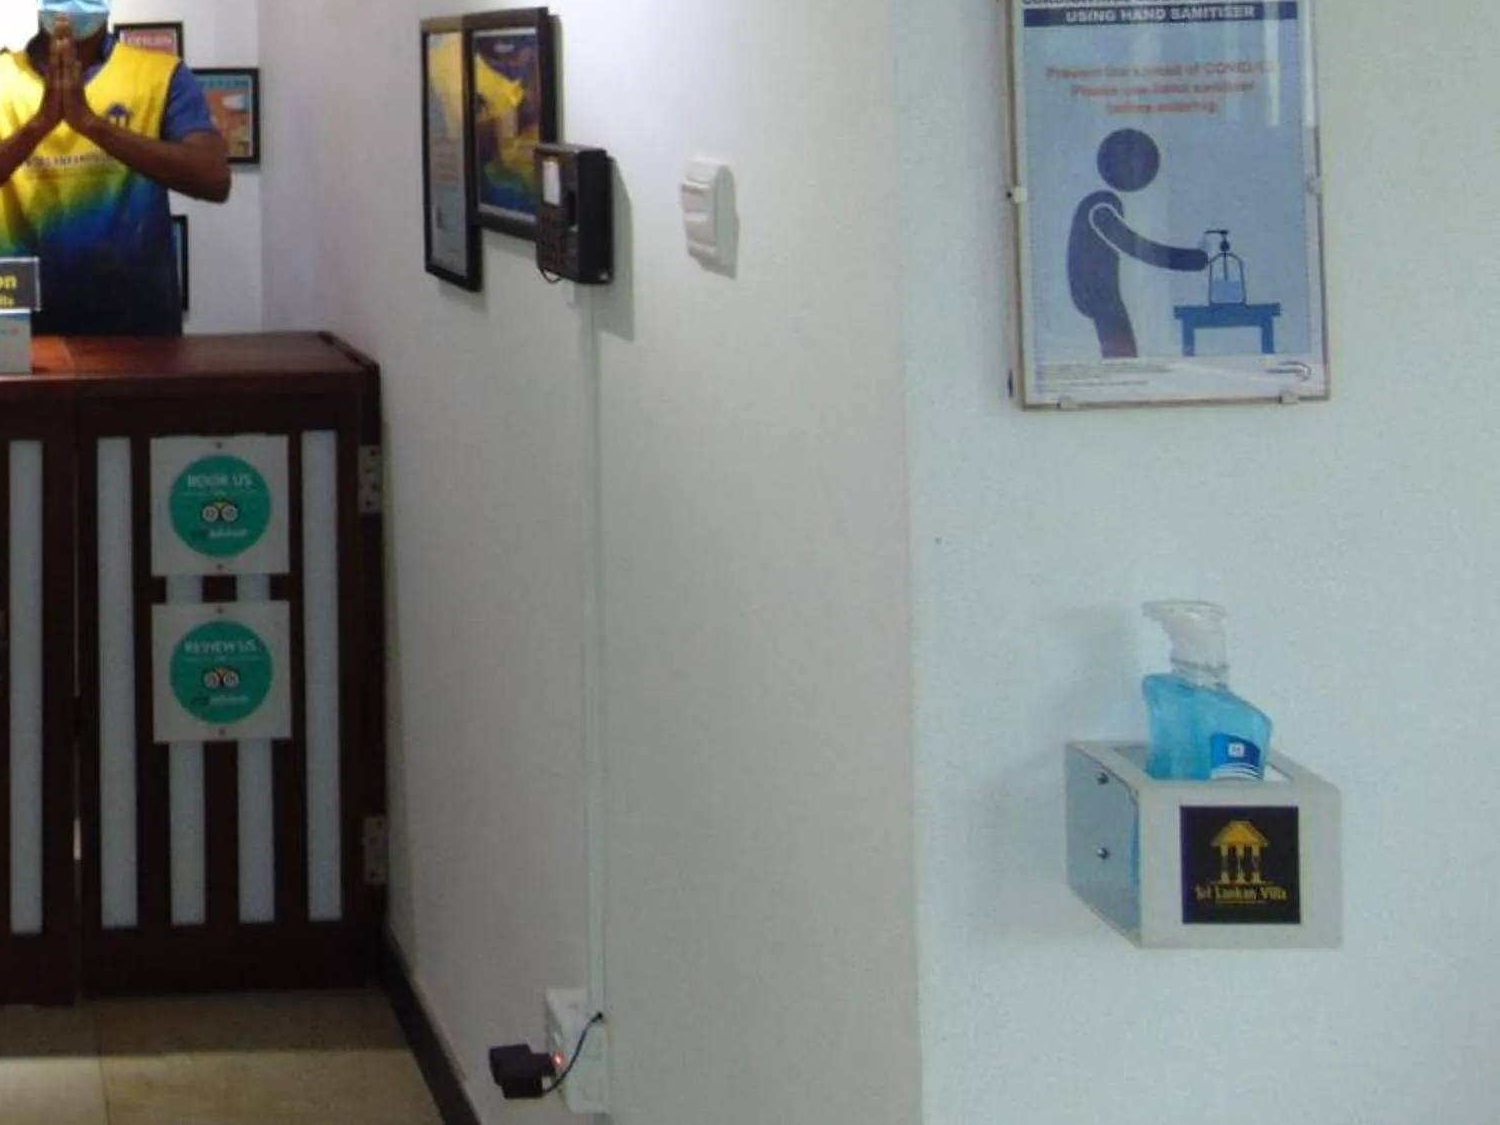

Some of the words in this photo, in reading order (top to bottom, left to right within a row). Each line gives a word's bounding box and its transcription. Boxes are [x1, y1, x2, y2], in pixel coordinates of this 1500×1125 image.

[1065, 8, 1116, 23] USING
[1121, 6, 1166, 21] HAND
[1171, 4, 1255, 20] SANITISER
